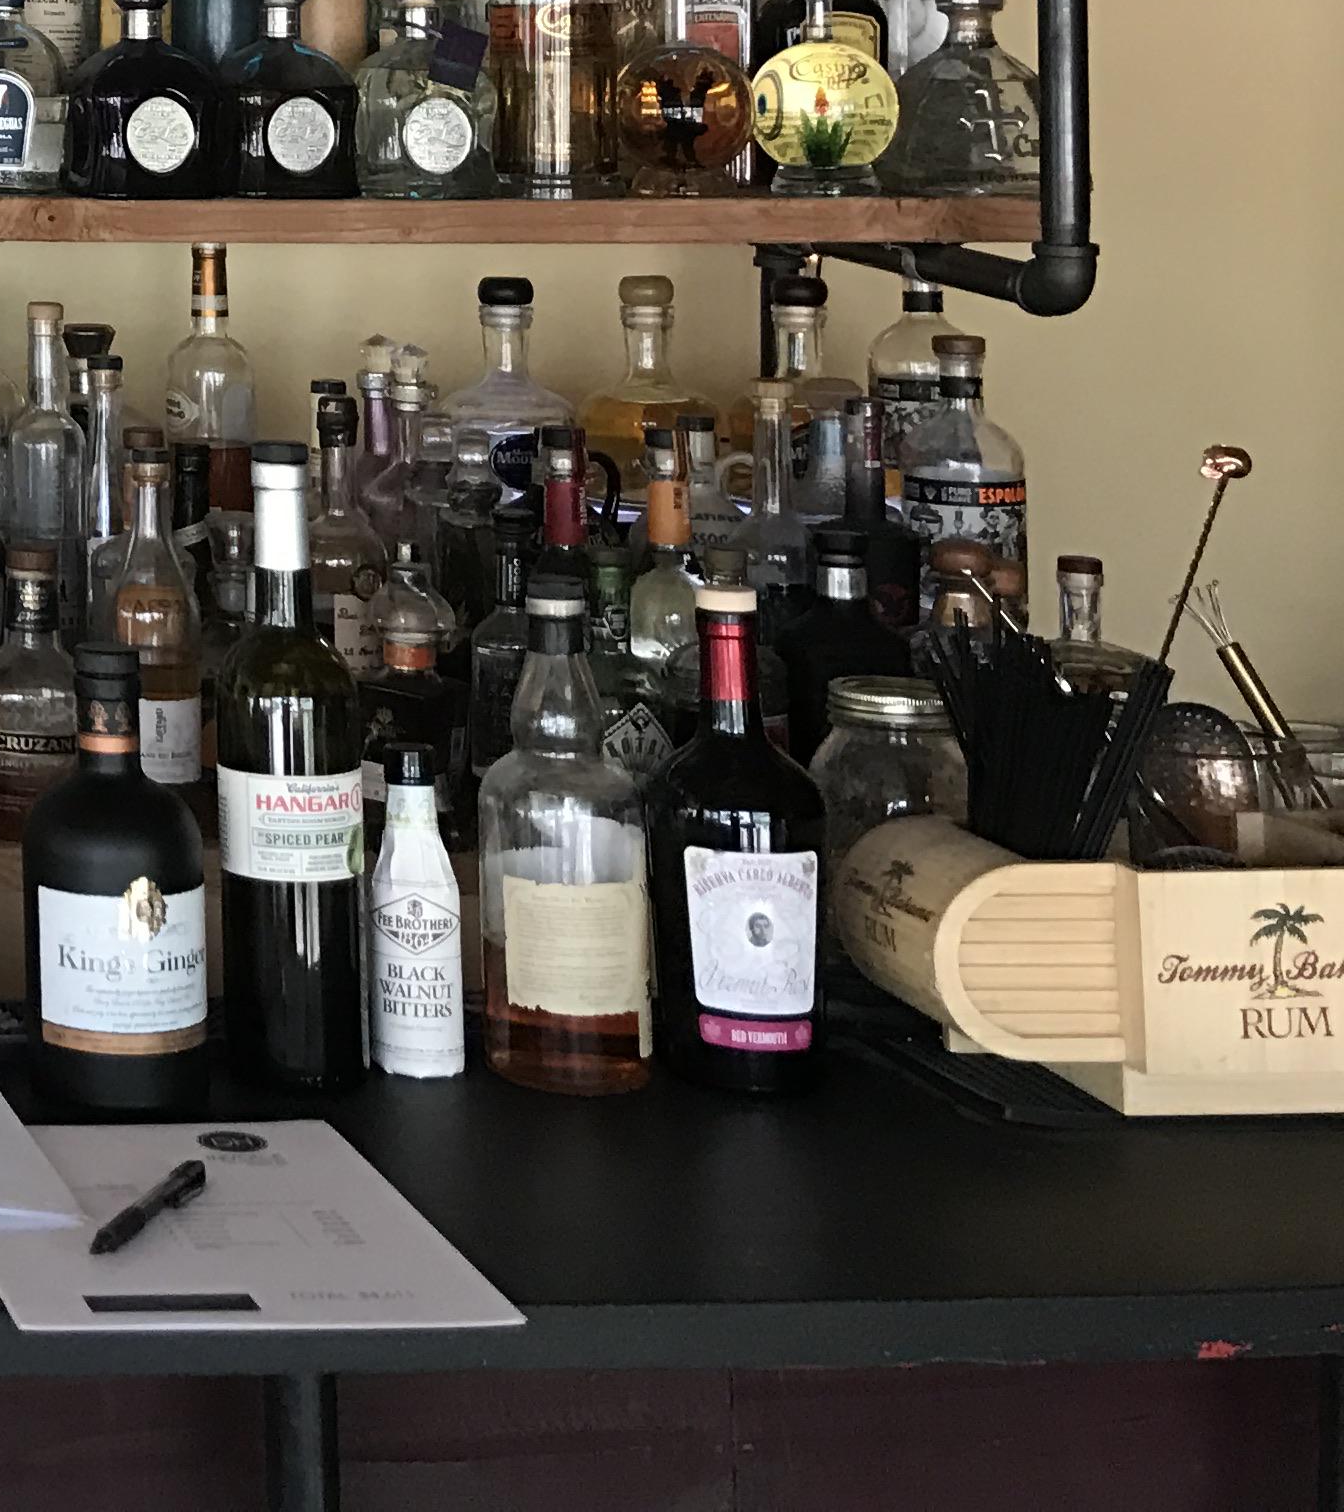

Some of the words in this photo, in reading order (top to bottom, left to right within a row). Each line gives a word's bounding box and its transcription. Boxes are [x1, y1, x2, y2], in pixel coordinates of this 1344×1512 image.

[255, 793, 349, 813] HANGAR
[377, 911, 394, 926] FEE
[395, 914, 453, 931] BROTHERS
[387, 963, 445, 982] BLACK
[1158, 954, 1267, 990] Tommy
[379, 981, 453, 1001] WALNUT
[382, 999, 452, 1018] BITTERS
[1239, 1006, 1334, 1040] RUM
